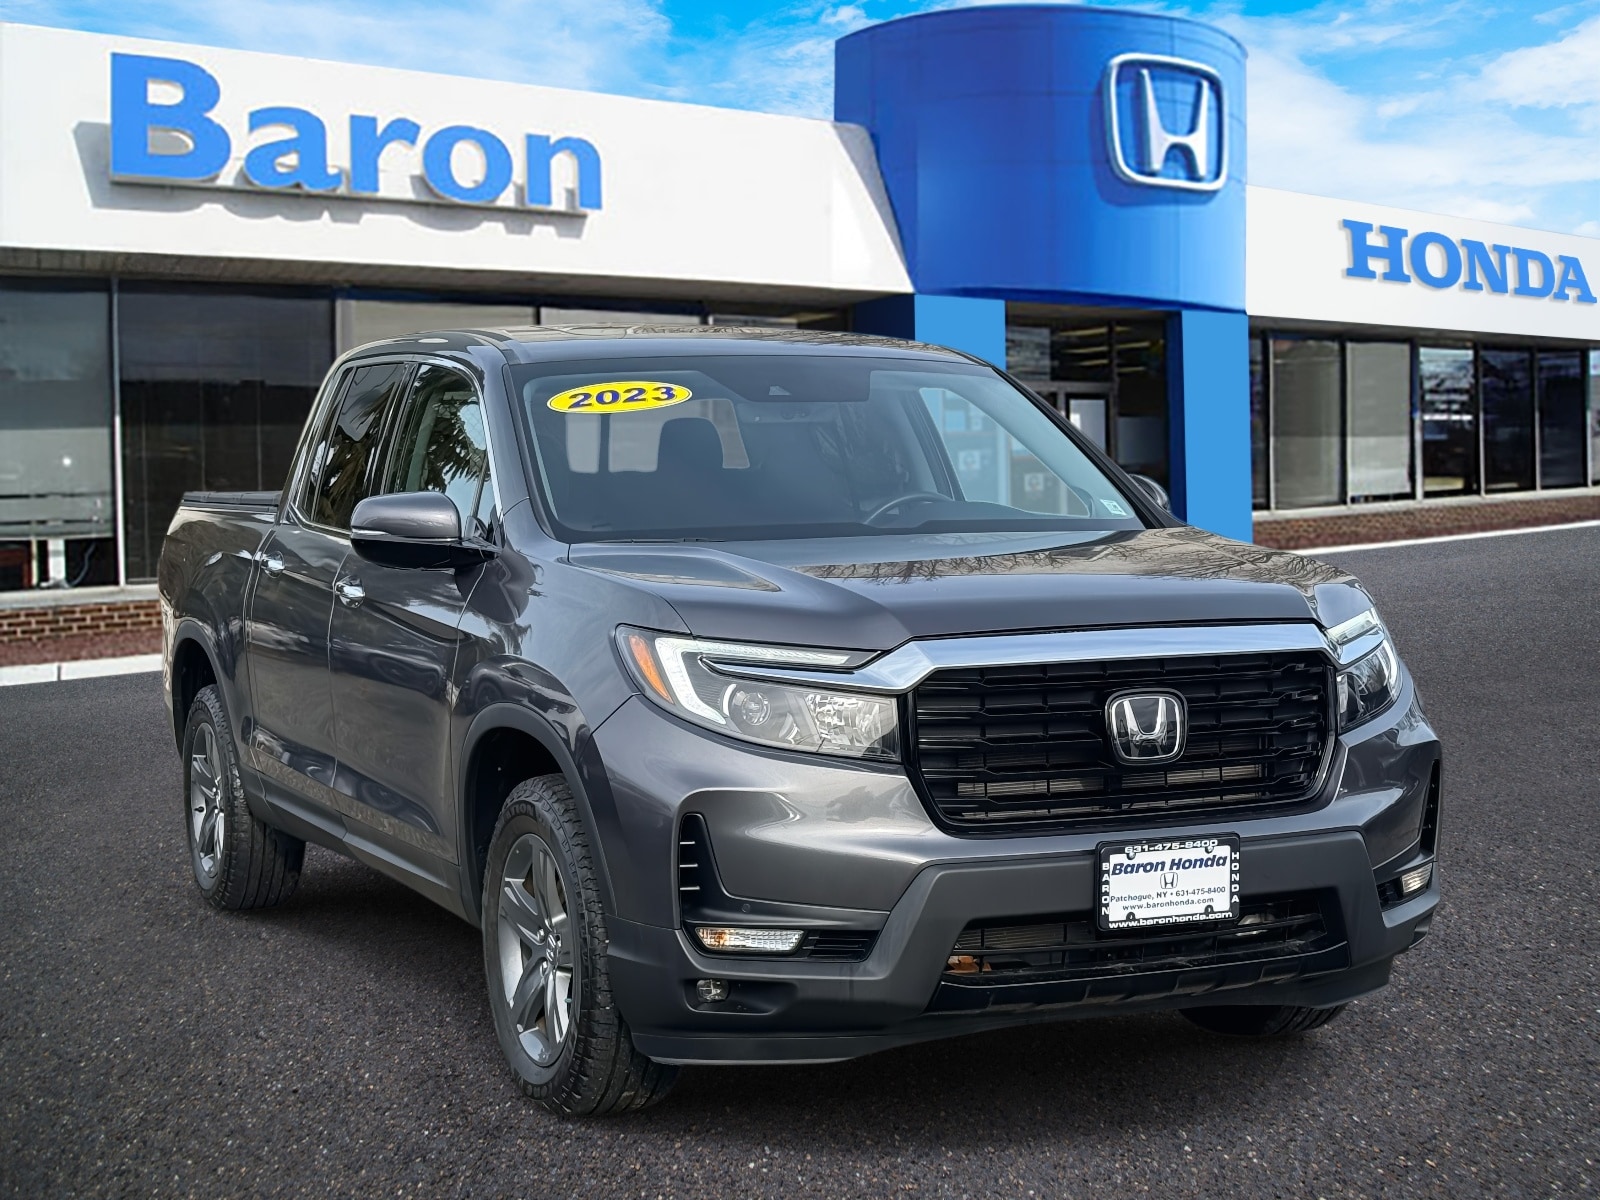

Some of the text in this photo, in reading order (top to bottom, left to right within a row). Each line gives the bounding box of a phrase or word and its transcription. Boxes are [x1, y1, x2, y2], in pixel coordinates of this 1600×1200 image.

[110, 52, 602, 210] Baron
[1342, 218, 1598, 304] HONDA
[567, 386, 676, 409] 2023
[1124, 839, 1218, 854] 631-475-8400
[1111, 854, 1228, 876] Baron Honda
[1231, 851, 1240, 903] HONDA
[1101, 862, 1110, 916] BARON
[1110, 886, 1226, 902] Patchogue, NY 631-475-8400
[1122, 897, 1214, 911] www.baronhonda.com
[1108, 911, 1233, 929] www.baronhonda.com
